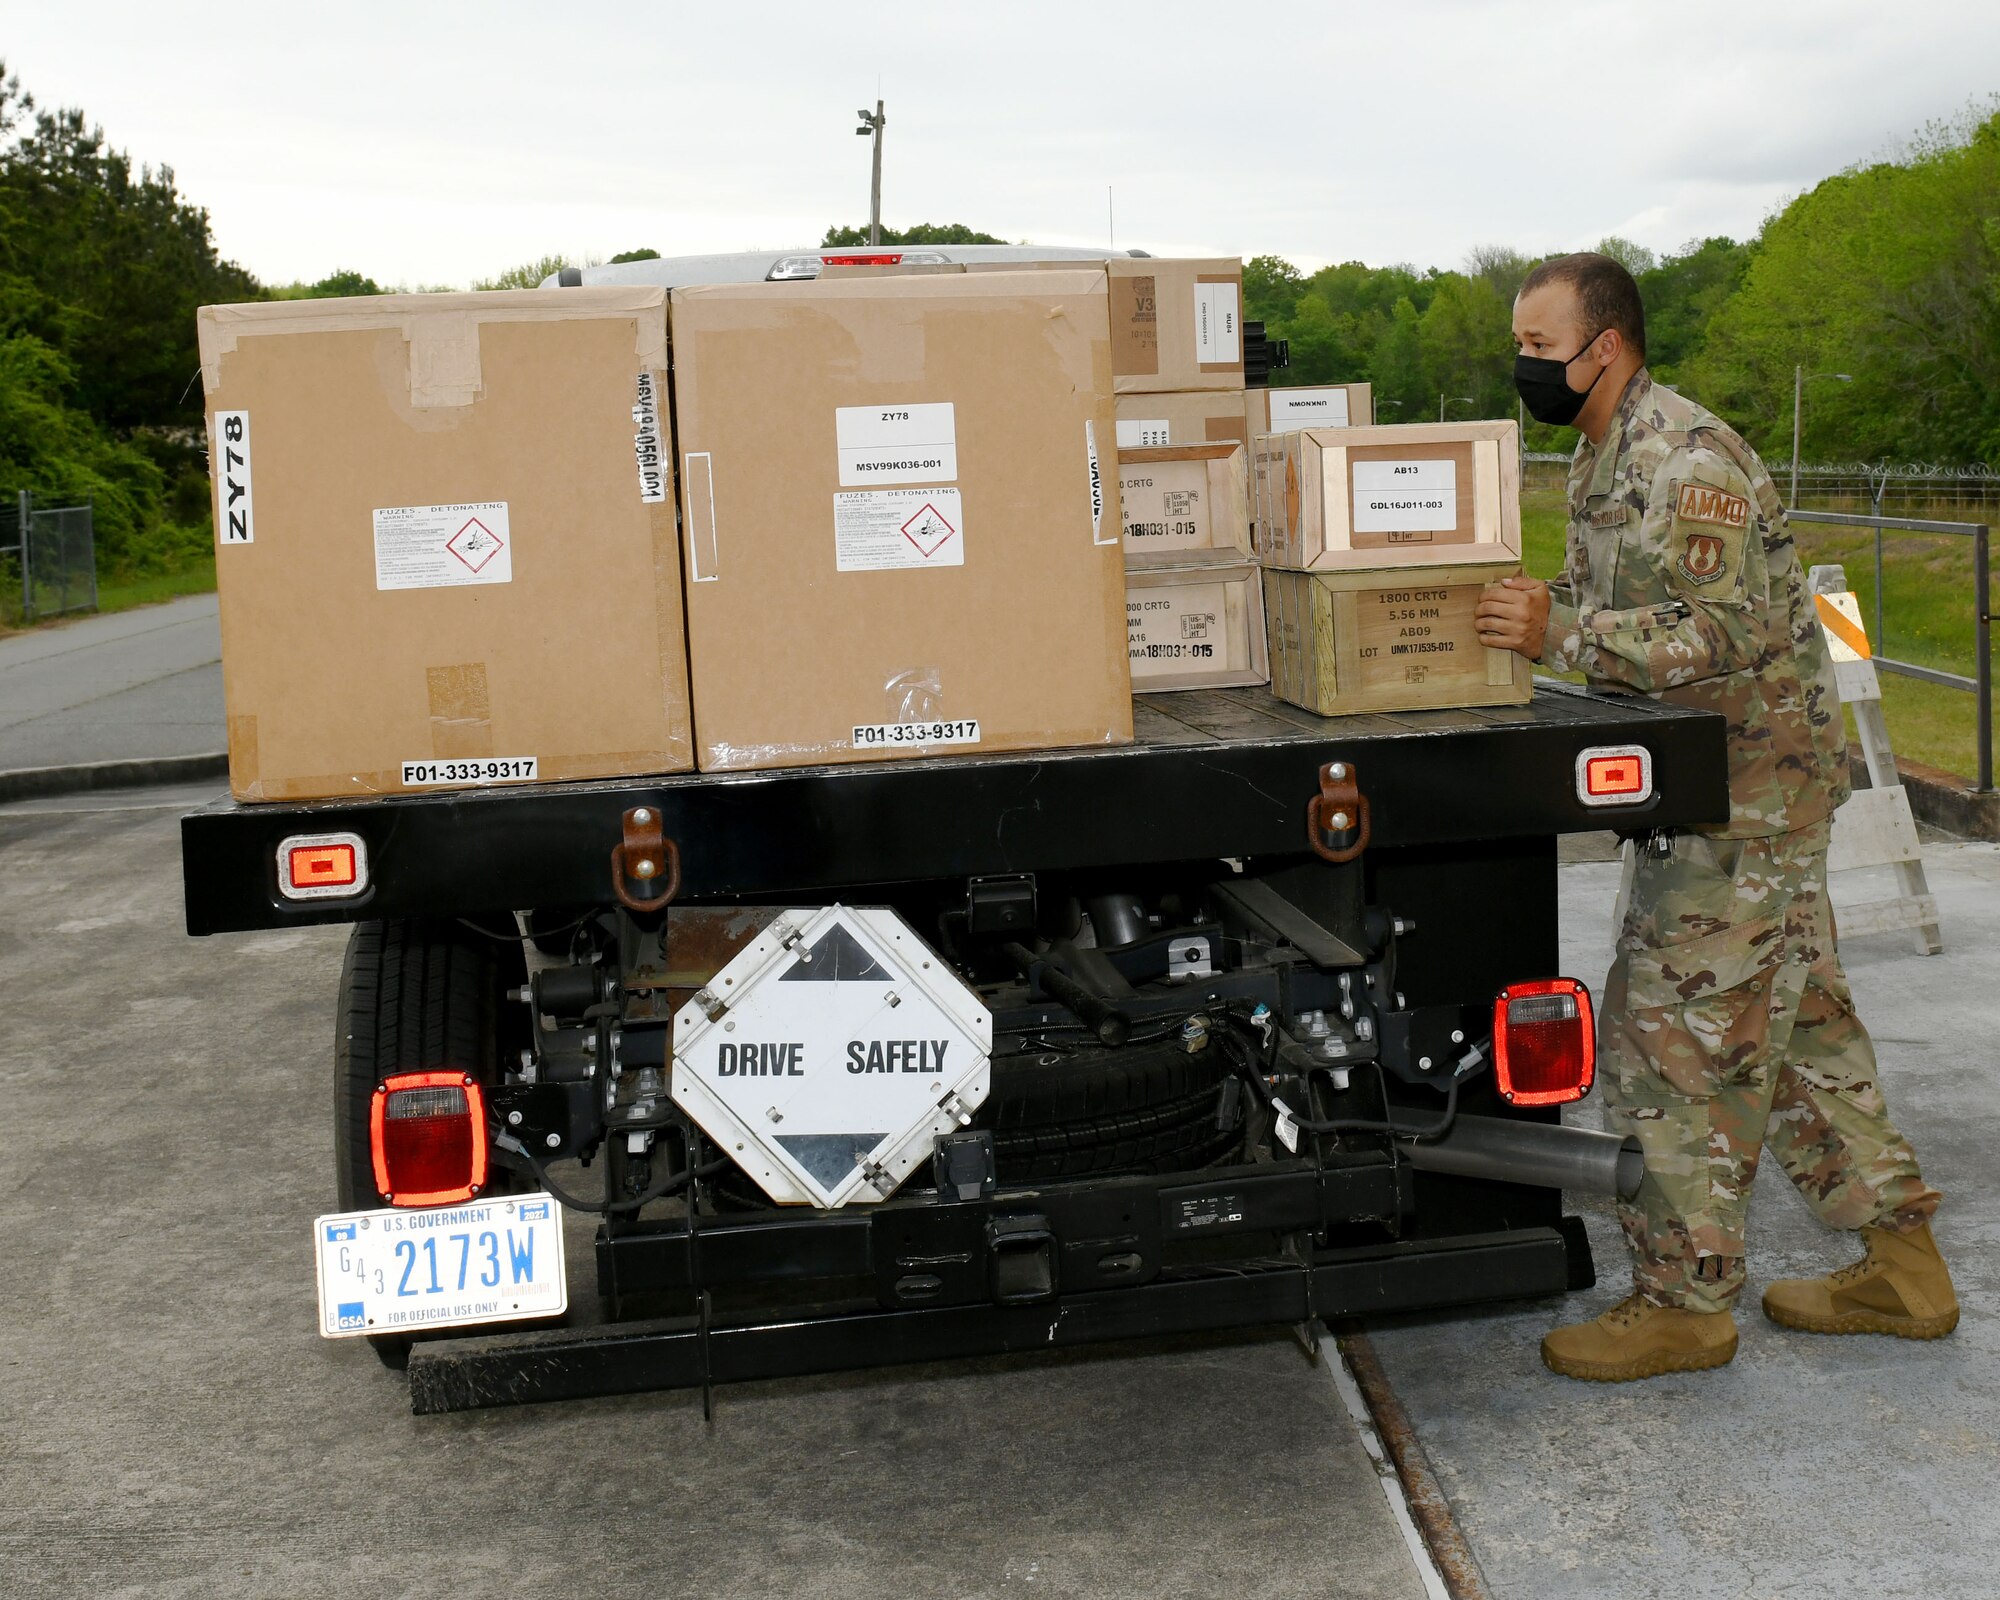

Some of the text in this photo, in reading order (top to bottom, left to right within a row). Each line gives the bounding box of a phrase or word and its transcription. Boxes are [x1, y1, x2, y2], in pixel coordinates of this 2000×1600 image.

[1135, 297, 1156, 312] V3
[880, 412, 909, 421] ZY78
[856, 460, 942, 471] MSV99K036-001
[1394, 466, 1418, 474] AB13
[224, 415, 247, 541] ZY78
[1127, 479, 1153, 488] CRTG
[887, 488, 956, 497] DETONATING
[430, 503, 504, 513] DETONATING
[1370, 501, 1443, 509] GDL16J011-003
[1683, 489, 1743, 523] AMMO
[1379, 591, 1448, 603] 1800 CRTG
[1144, 601, 1171, 610] CRTG
[1389, 608, 1440, 620] 5.56 MM
[1400, 626, 1431, 637] AB09
[1360, 641, 1454, 658] LOT UMK17J535-012
[853, 721, 977, 743] F01-333-9317
[403, 761, 534, 782] F01-333-9317
[718, 1040, 949, 1076] DRIVE SAFELY
[383, 1207, 492, 1232] U.S. GOVERNMENT
[524, 1210, 545, 1221] 2027
[336, 1231, 348, 1241] 09
[394, 1226, 534, 1297] 2173W
[388, 1301, 498, 1324] FOR OFFICIAL USE ONLY
[339, 1315, 365, 1328] GSA
